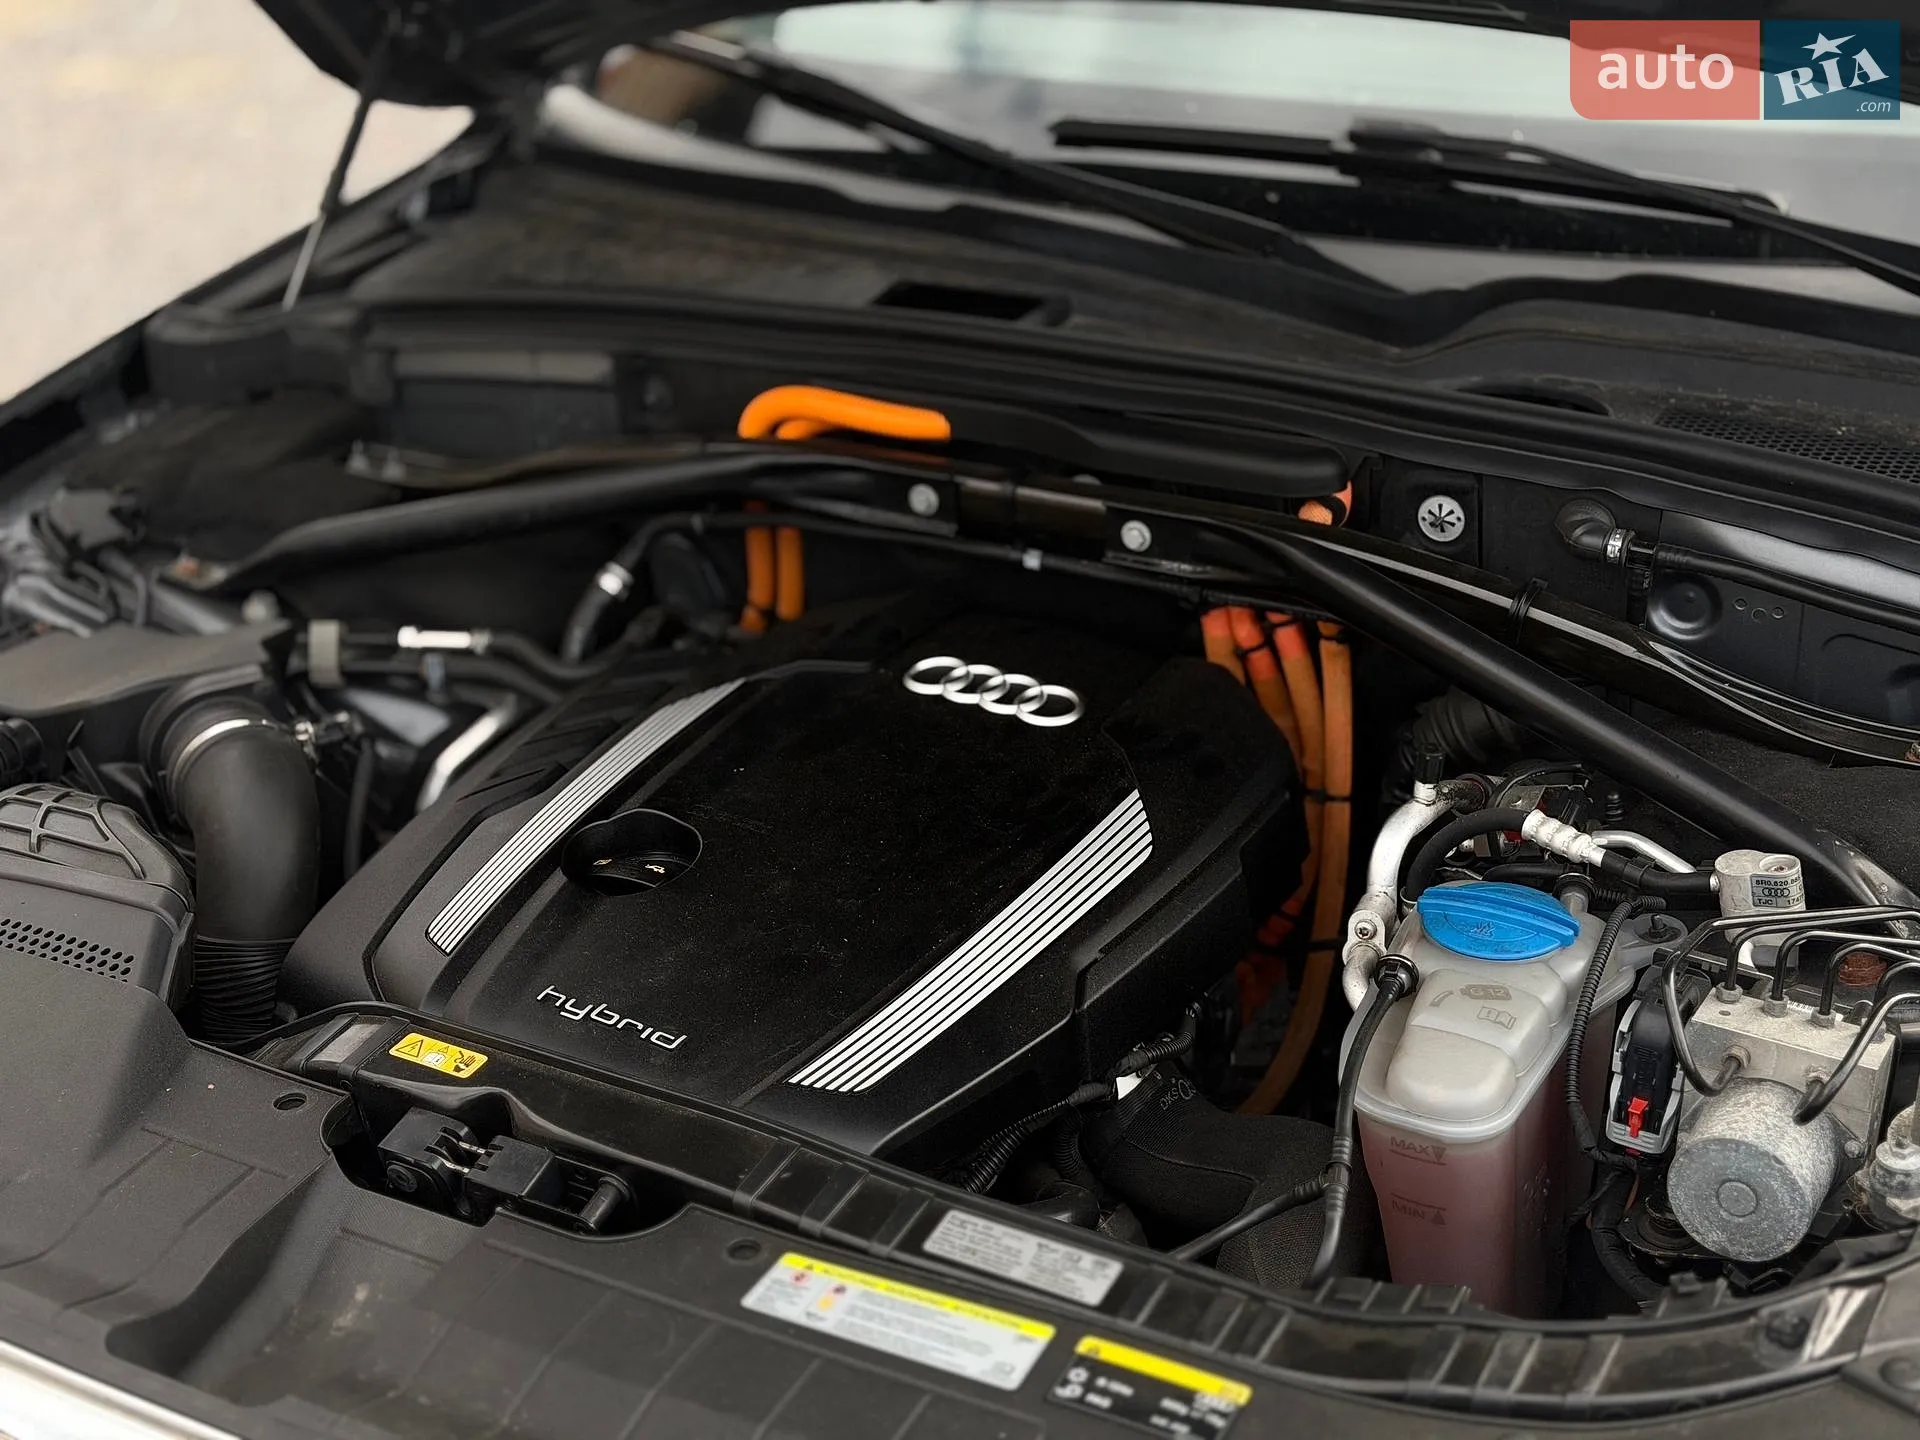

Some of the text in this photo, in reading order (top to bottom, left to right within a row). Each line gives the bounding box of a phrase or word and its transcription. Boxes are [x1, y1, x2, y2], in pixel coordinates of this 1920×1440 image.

[536, 985, 688, 1049] hybrid
[1390, 1136, 1431, 1156] MAX
[1392, 1199, 1425, 1220] MIN
